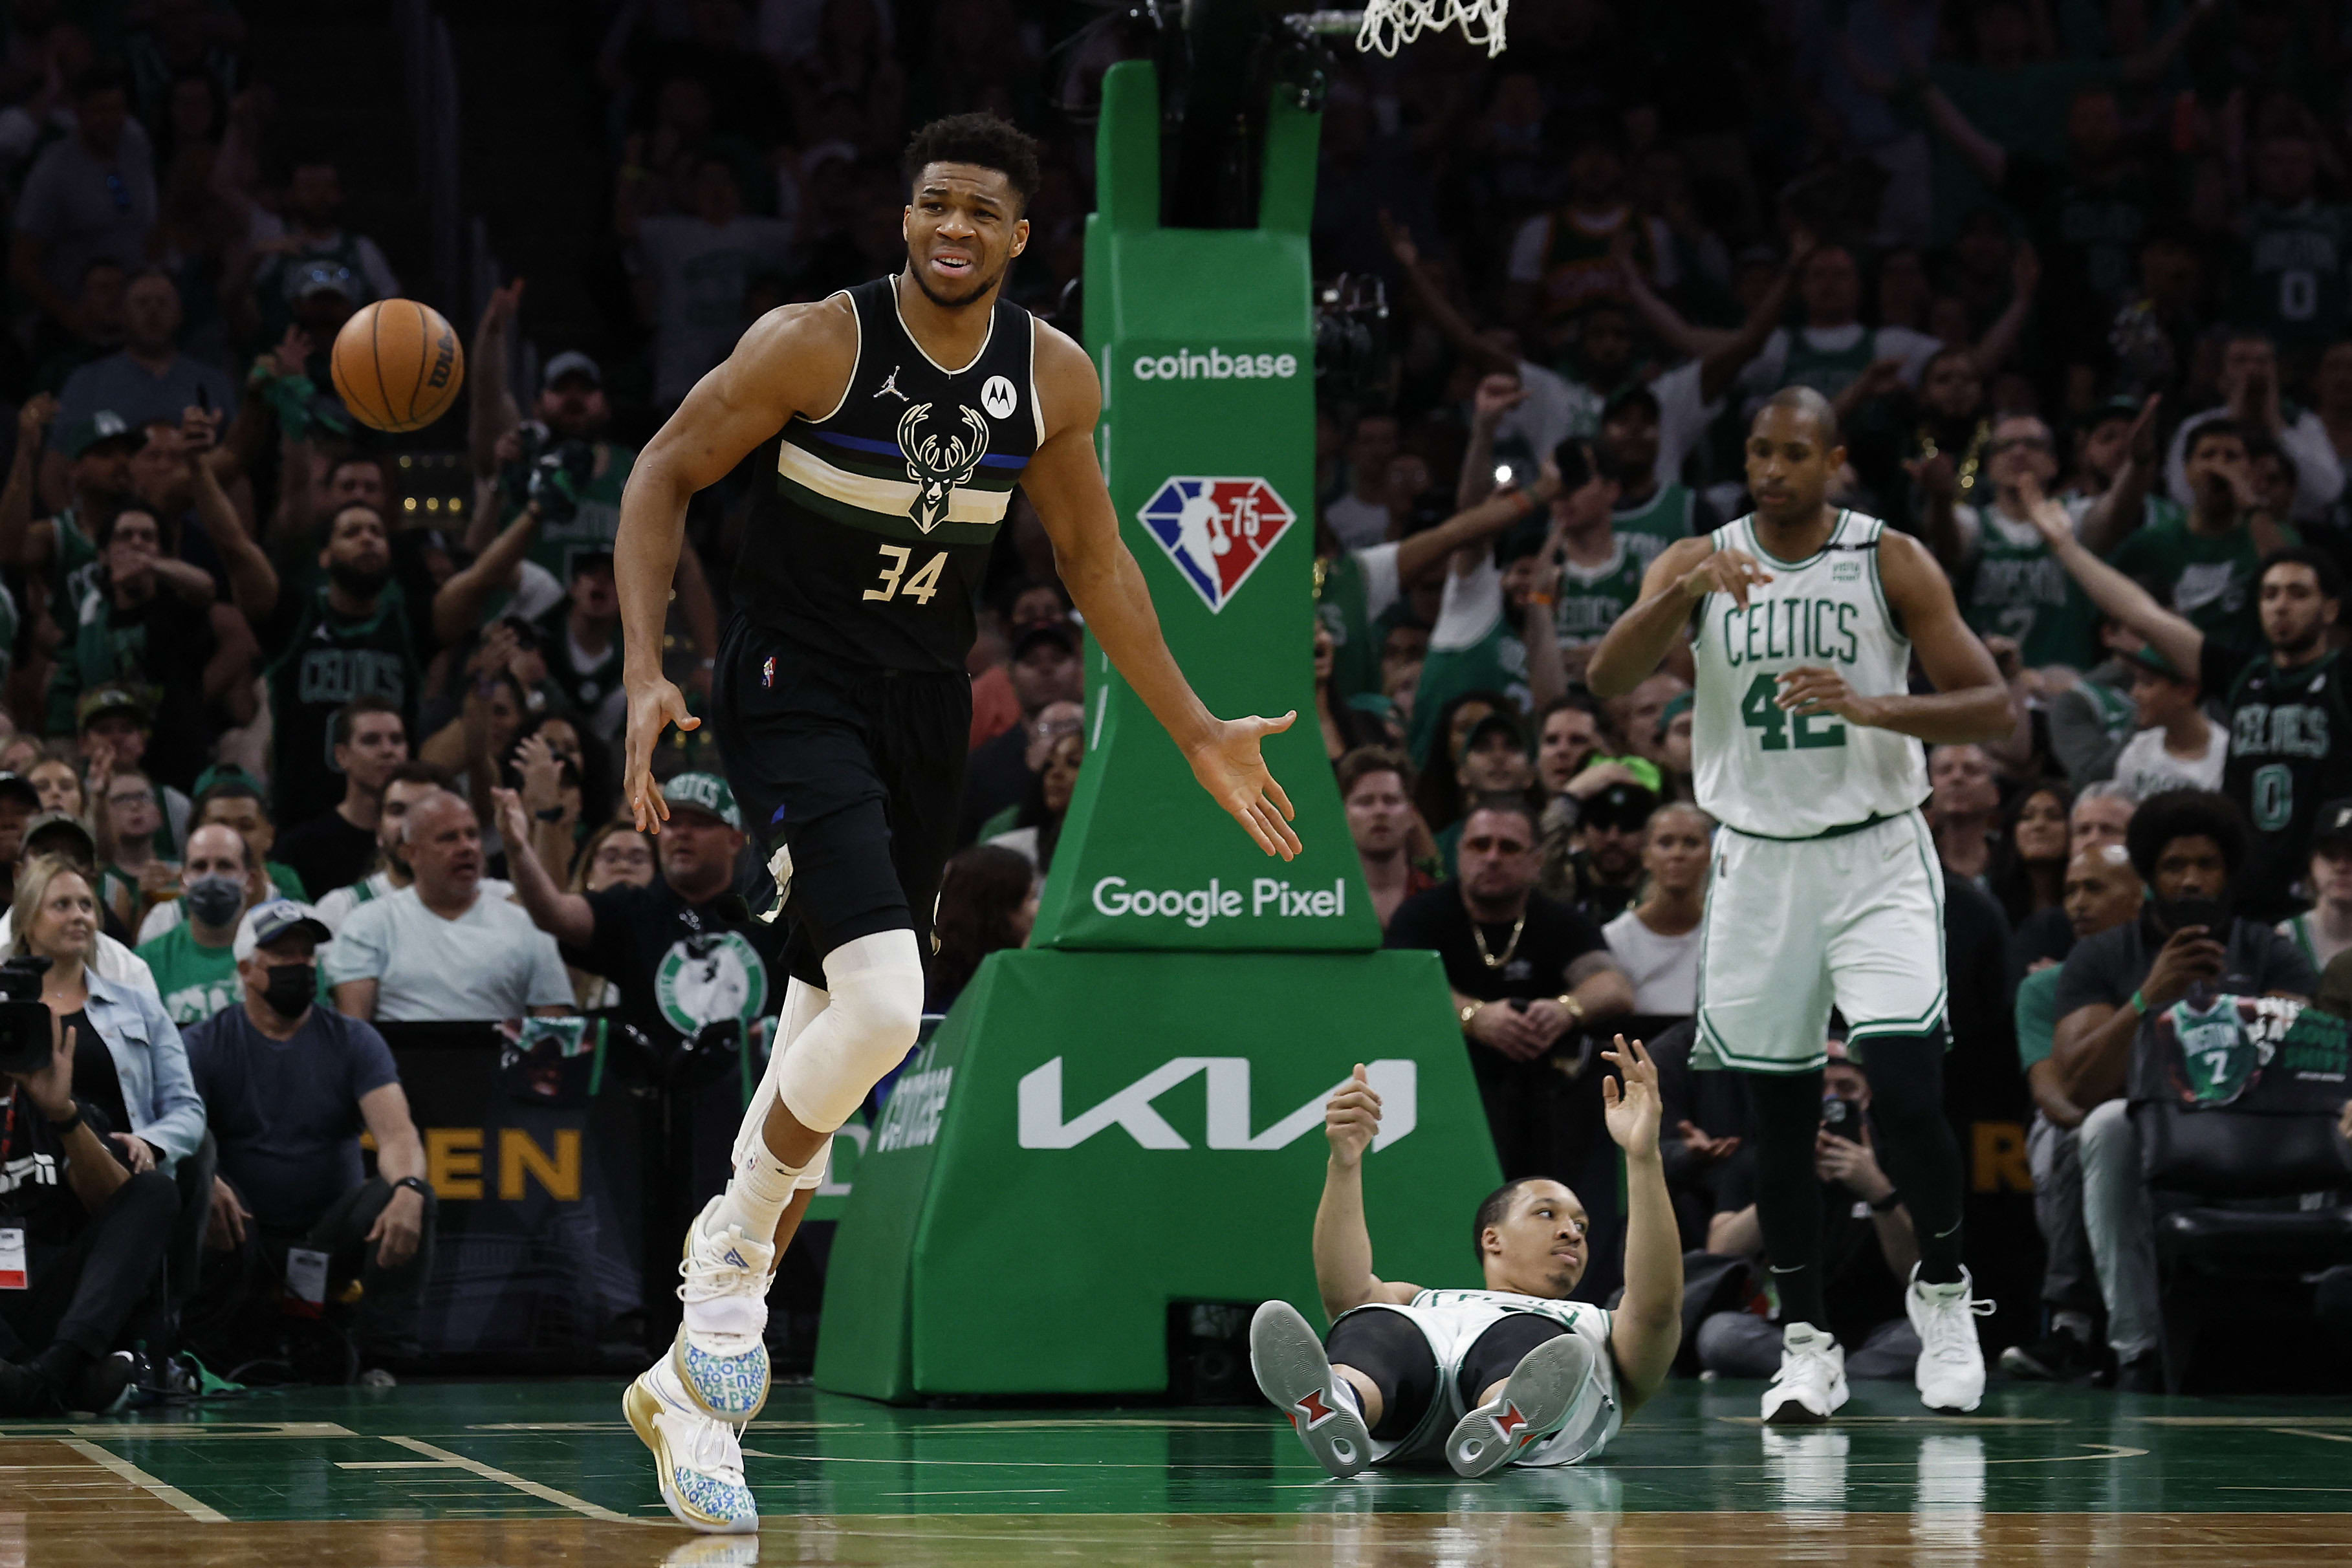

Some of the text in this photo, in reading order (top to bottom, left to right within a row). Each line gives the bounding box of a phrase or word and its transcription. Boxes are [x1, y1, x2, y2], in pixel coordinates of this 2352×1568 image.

[1133, 347, 1298, 380] coinbase
[1229, 496, 1260, 537] 75
[862, 543, 949, 605] 34
[1725, 597, 1859, 668] CELTICS
[2232, 702, 2332, 759] CELTICS
[2252, 763, 2294, 832] 0
[1092, 875, 1345, 928] Google Pixel
[2203, 1049, 2230, 1085] 7
